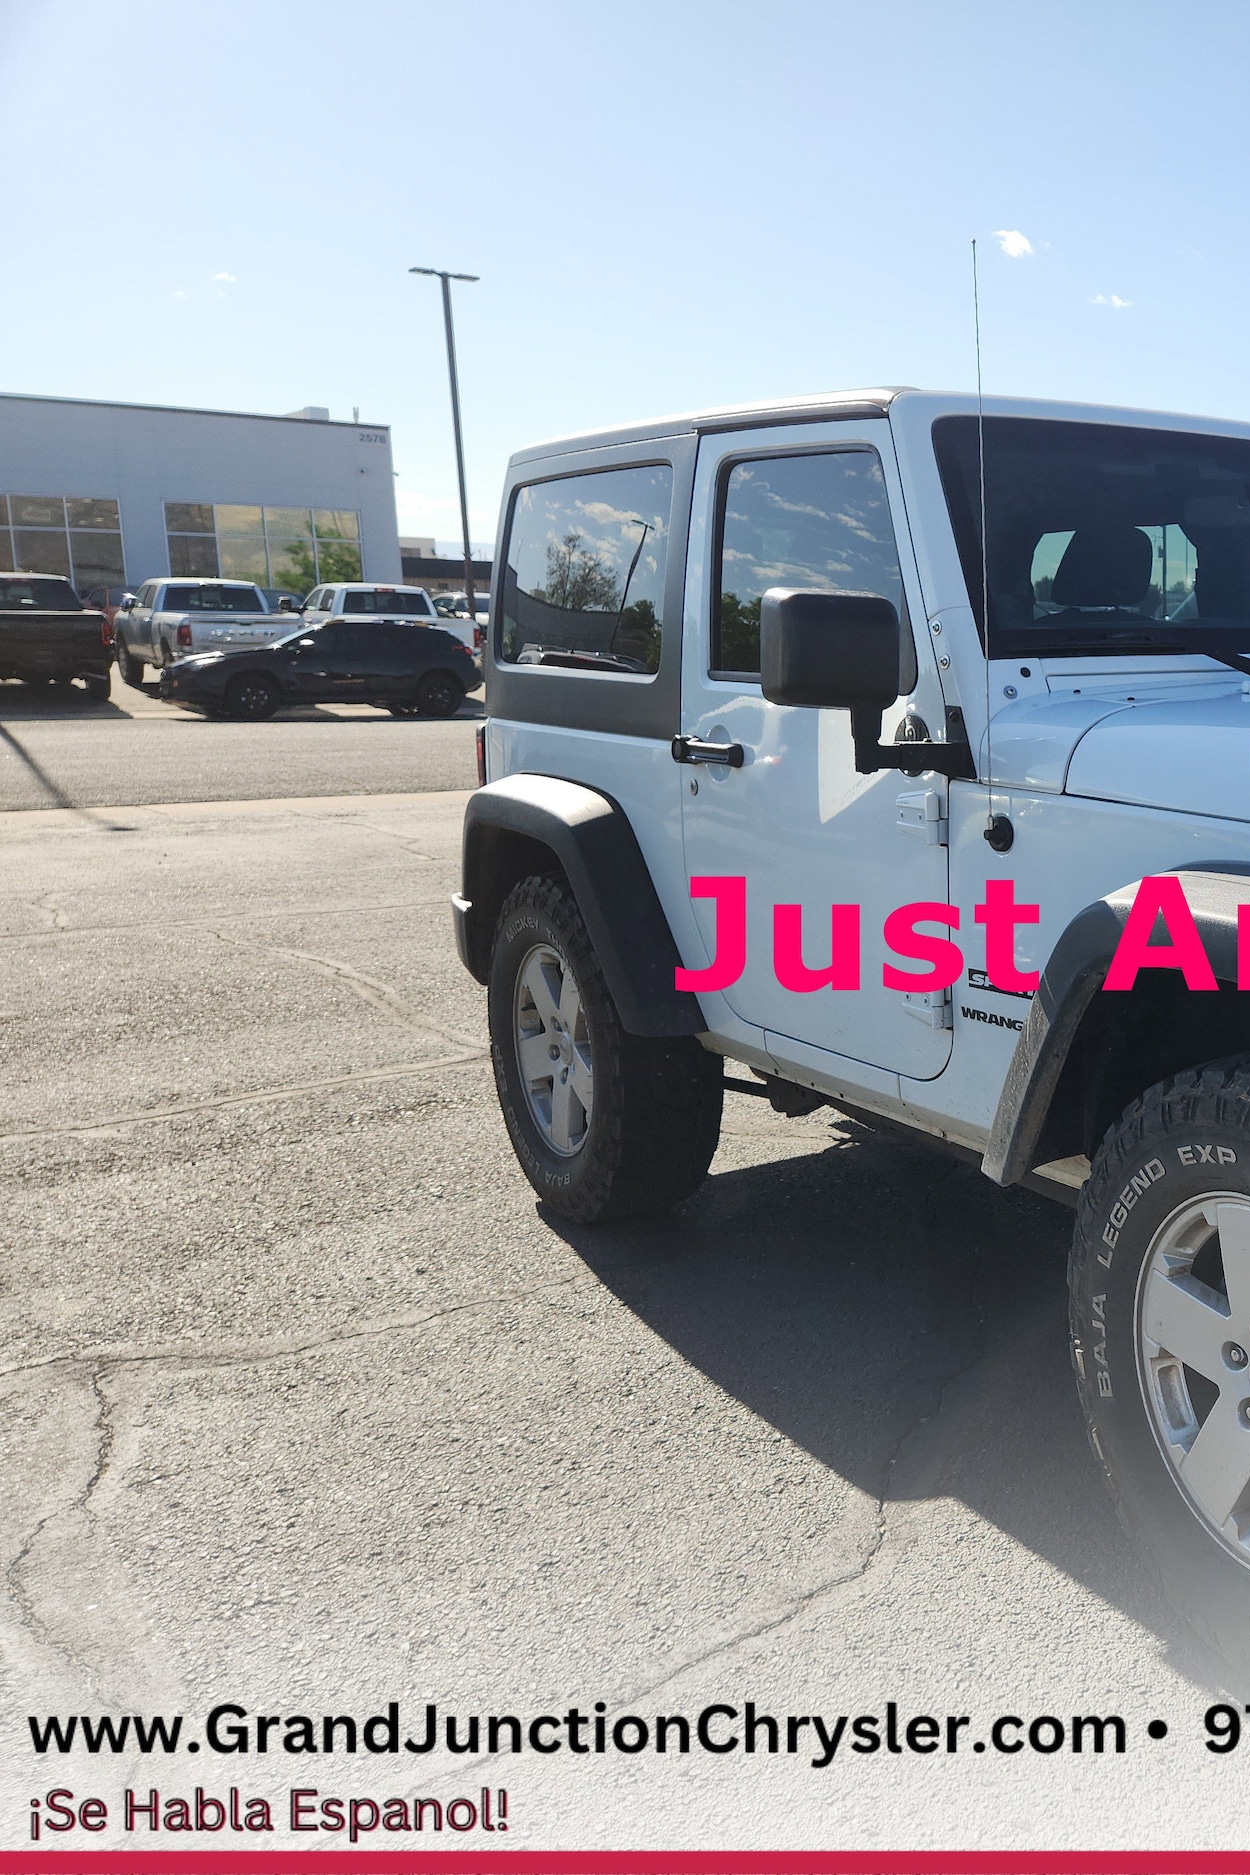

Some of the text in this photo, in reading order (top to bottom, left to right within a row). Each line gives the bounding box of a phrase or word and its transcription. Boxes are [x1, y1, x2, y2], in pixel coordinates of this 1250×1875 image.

[505, 917, 540, 943] MICKEY
[961, 1006, 1024, 1031] WRANG
[1092, 1144, 1238, 1397] BAJA LEGEND EXP
